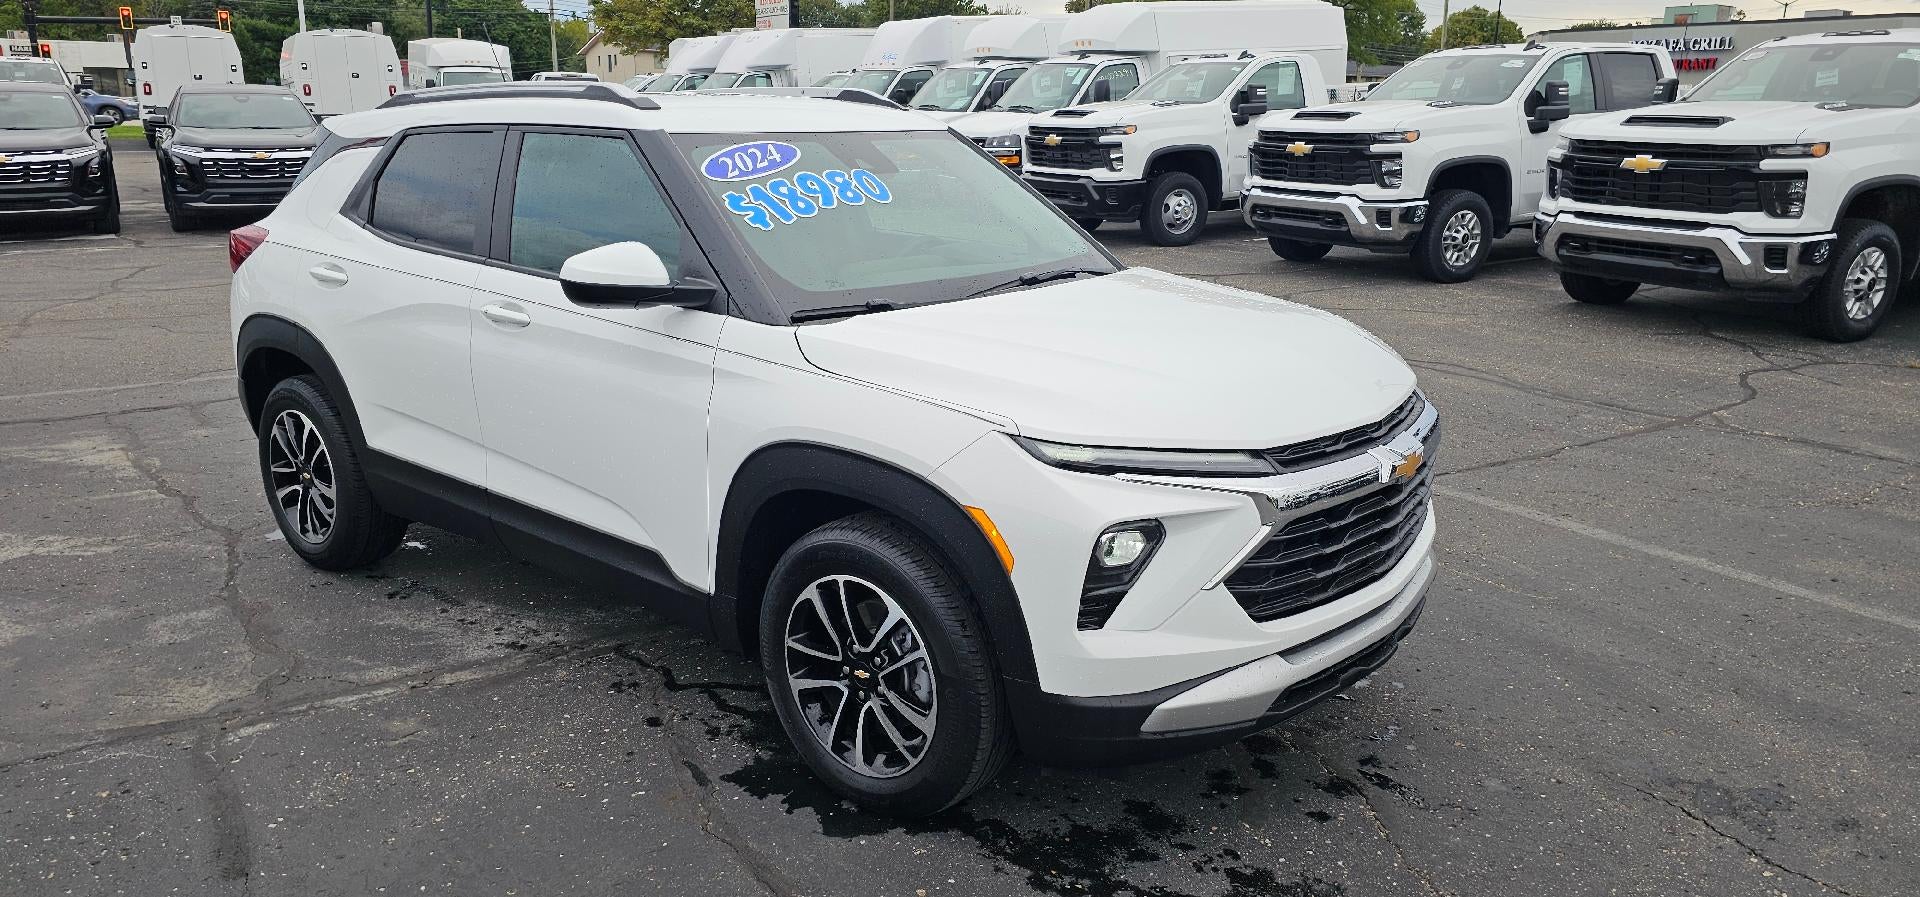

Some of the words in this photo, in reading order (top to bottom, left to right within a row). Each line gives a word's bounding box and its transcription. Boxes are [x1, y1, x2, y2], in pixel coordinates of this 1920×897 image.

[1689, 36, 1735, 51] GRILL
[1672, 57, 1718, 71] URANT
[718, 143, 782, 179] 2024
[722, 169, 892, 230] $18980
